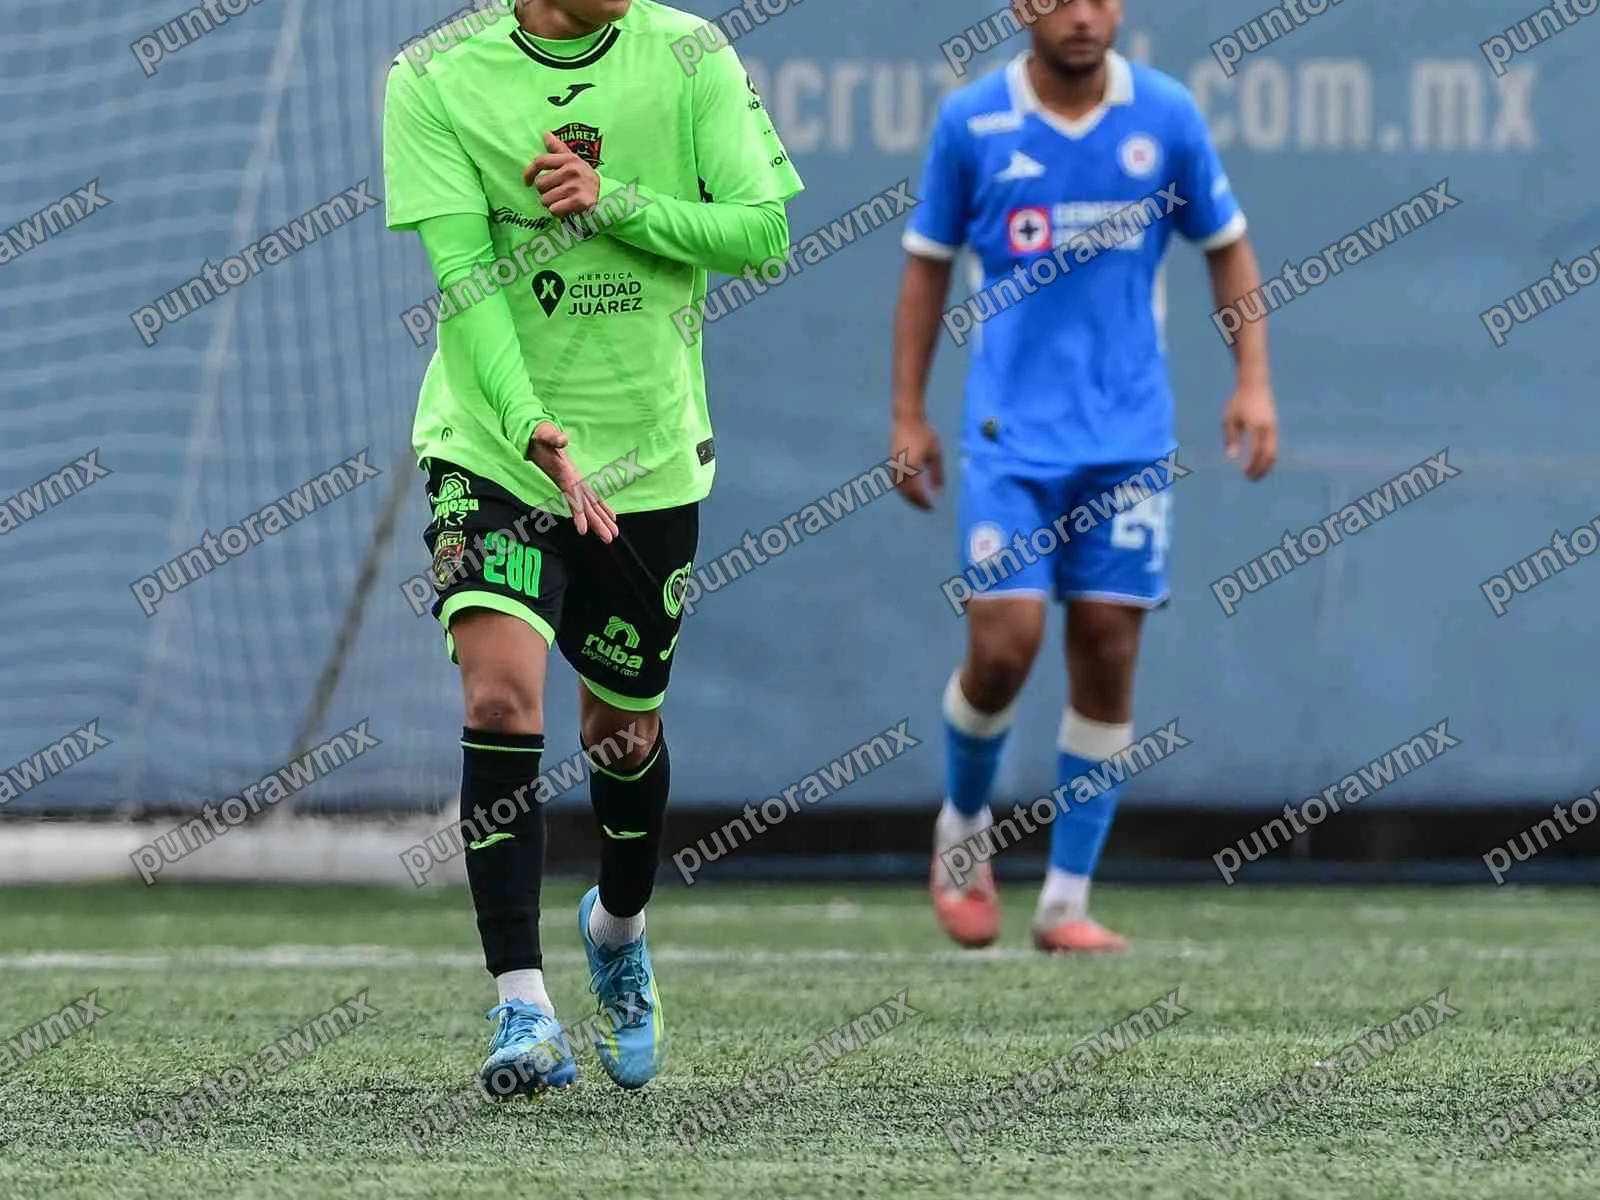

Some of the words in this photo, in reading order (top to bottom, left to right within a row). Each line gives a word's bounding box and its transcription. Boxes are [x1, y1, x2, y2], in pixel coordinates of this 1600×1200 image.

[578, 272, 633, 281] HEROICA
[569, 281, 641, 299] CIUDAD
[568, 297, 643, 315] JUÁREZ
[483, 531, 542, 599] 280
[585, 634, 643, 669] ruba
